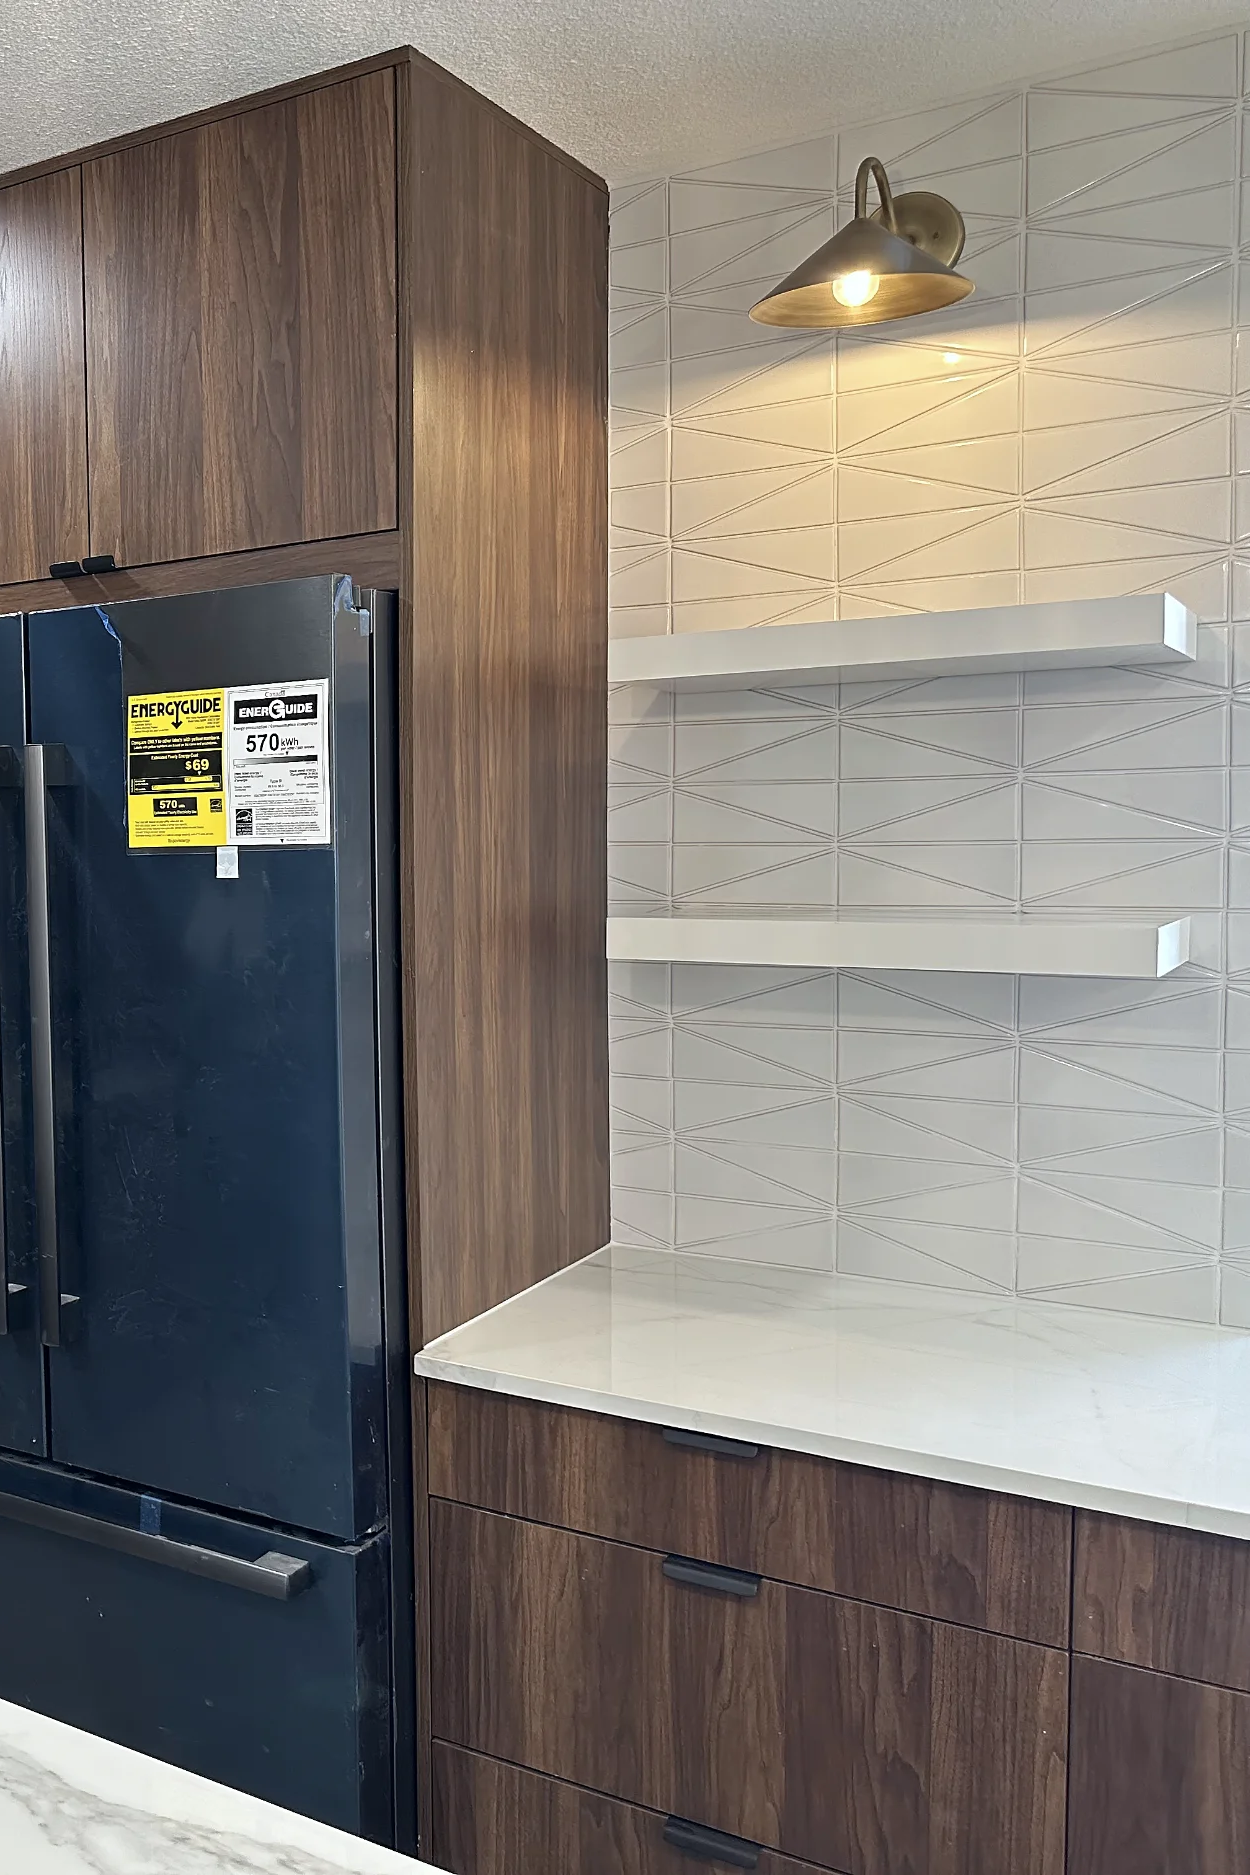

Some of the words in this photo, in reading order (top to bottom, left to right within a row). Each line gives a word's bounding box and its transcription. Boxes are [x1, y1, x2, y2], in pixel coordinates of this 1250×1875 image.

[131, 697, 221, 719] ENERGYGUIDE
[238, 699, 313, 719] ENERGUIDE
[246, 733, 279, 752] 570
[281, 737, 299, 746] kWh
[185, 759, 210, 771] $69
[159, 799, 178, 809] 570
